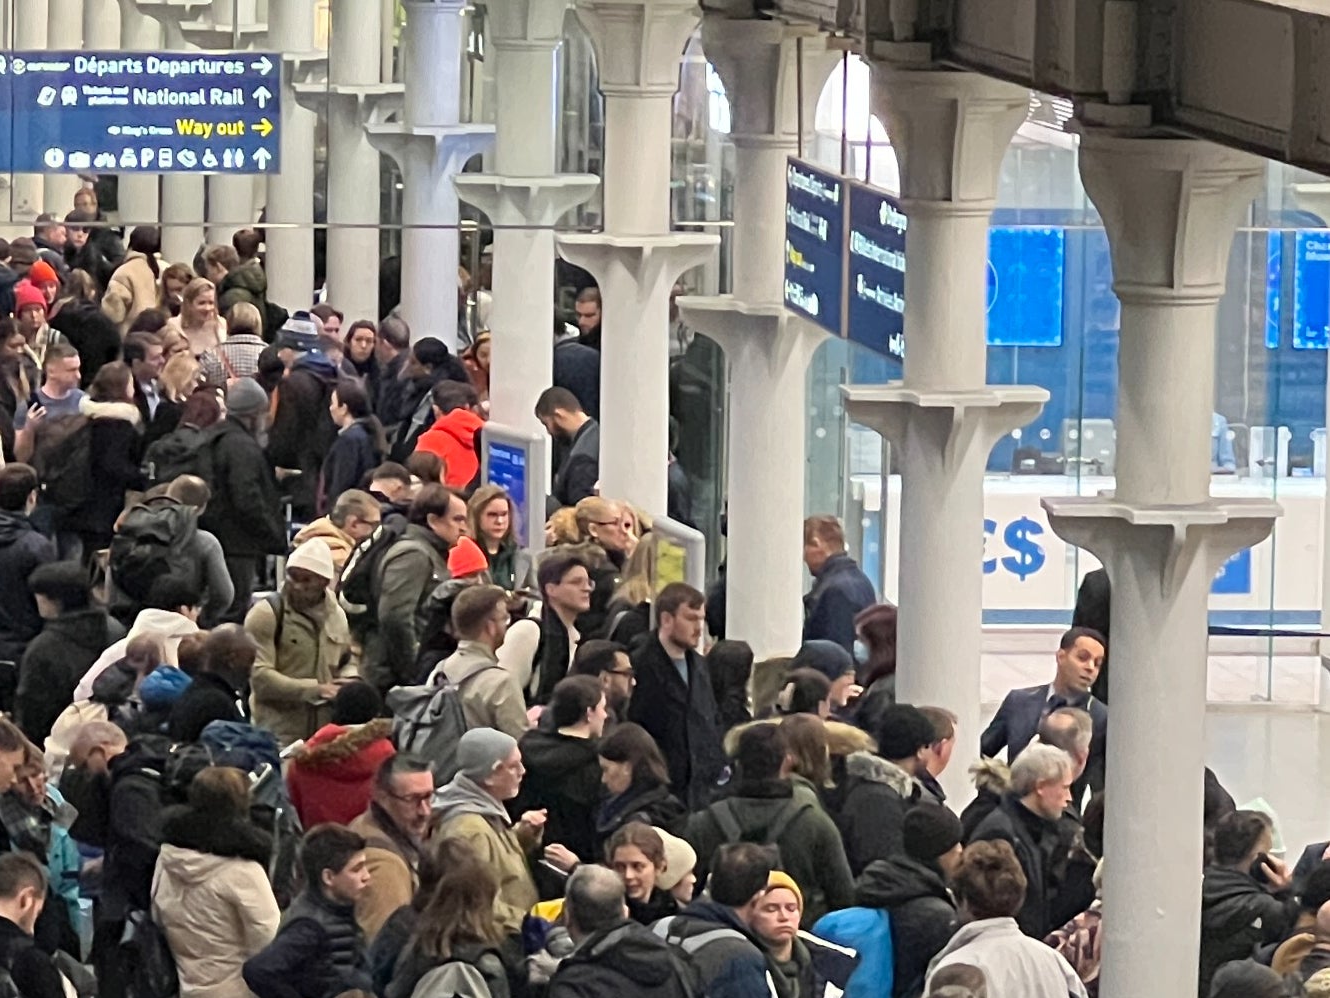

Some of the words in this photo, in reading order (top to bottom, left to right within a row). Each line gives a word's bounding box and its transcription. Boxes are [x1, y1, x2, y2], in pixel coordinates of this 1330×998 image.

[74, 55, 143, 76] Départs
[147, 57, 244, 77] Departures
[133, 86, 206, 106] National
[210, 87, 244, 106] Rail
[175, 118, 213, 139] Way
[217, 120, 245, 136] out
